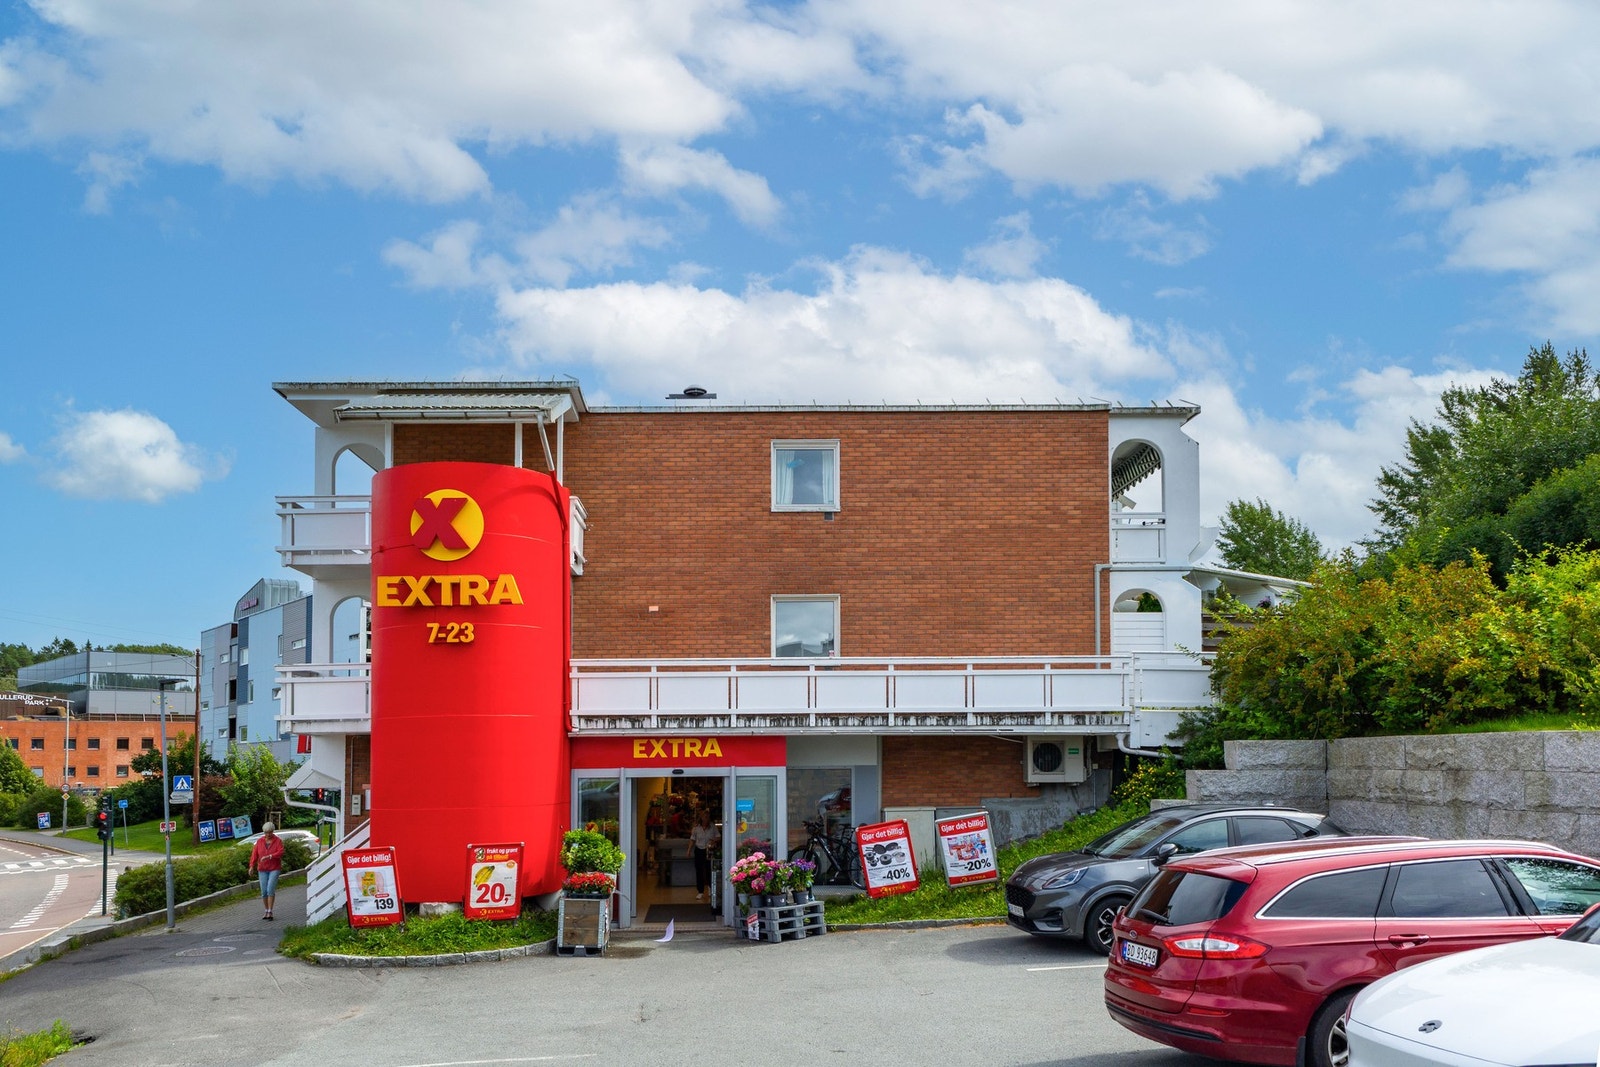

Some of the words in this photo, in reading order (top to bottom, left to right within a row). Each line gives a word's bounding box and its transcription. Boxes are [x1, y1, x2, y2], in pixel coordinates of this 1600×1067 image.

[377, 573, 524, 607] EXTRA
[426, 622, 475, 644] 7-23
[633, 738, 723, 759] EXTRA
[941, 824, 955, 833] Gjør
[956, 822, 967, 830] det
[968, 817, 986, 828] billig!
[862, 832, 875, 841] Gjør
[875, 831, 886, 839] det
[887, 827, 905, 837] billig!
[347, 856, 360, 865] Gjør
[361, 855, 373, 863] det
[373, 853, 392, 863] billig!
[964, 857, 992, 872] -20%
[882, 867, 911, 881] -40%
[374, 898, 394, 910] 139
[1126, 943, 1136, 957] BD
[1136, 946, 1157, 964] 93648
